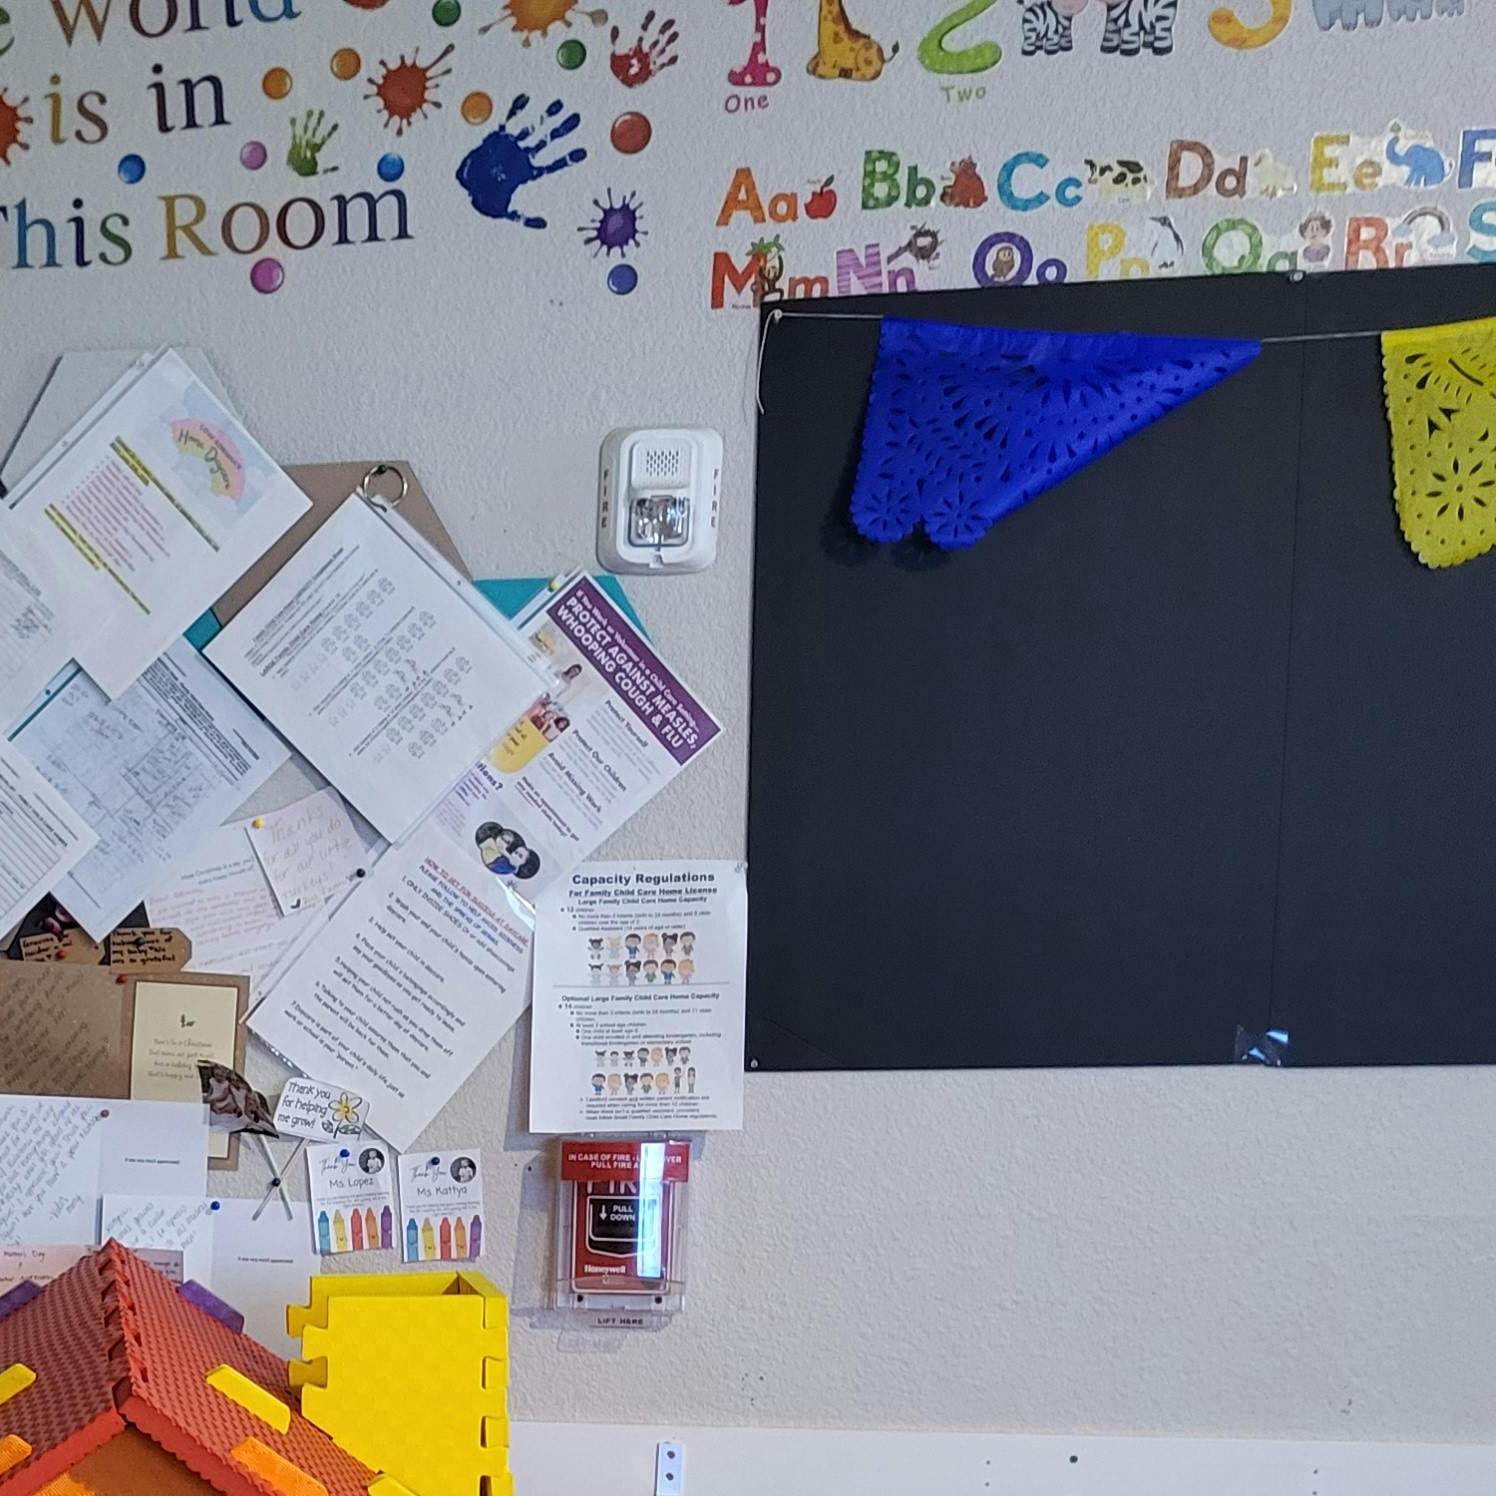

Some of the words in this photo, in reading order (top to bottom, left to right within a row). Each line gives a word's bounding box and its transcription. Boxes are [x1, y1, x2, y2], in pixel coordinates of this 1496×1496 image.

[45, 73, 109, 145] is
[147, 63, 231, 135] in
[724, 95, 769, 114] One
[941, 86, 986, 104] Two
[157, 186, 415, 261] Room
[601, 469, 609, 528] FIRE
[710, 469, 719, 528] FIRE
[554, 604, 617, 673] WHOOPING
[612, 670, 654, 715] COUGH
[650, 713, 664, 727] &
[660, 724, 683, 749] FLU
[564, 596, 611, 646] PROTECT
[606, 643, 656, 697] AGAINST
[649, 692, 701, 751] MEASLES,
[648, 672, 666, 691] Child
[662, 688, 679, 706] Care
[604, 699, 626, 723] Protect
[571, 728, 593, 753] Protect
[591, 751, 605, 765] Our
[602, 764, 628, 792] Children
[547, 751, 566, 771] Avoid
[562, 769, 587, 796] Missing
[584, 793, 603, 813] Work
[572, 873, 630, 887] Capacity
[635, 872, 714, 885] Regulations
[584, 889, 611, 897] Family
[591, 994, 608, 1002] Large
[611, 994, 631, 1002] Family
[691, 992, 719, 1000] Capacity
[287, 1080, 314, 1097] Thank
[313, 1088, 331, 1102] you
[281, 1094, 294, 1108] for
[293, 1096, 328, 1118] helping
[277, 1111, 290, 1123] me
[289, 1112, 316, 1132] grow!
[568, 1153, 576, 1161] IN
[578, 1153, 599, 1161] CASE
[600, 1153, 612, 1161] OF
[591, 1161, 611, 1169] PULL
[613, 1161, 632, 1169] FIRE
[347, 1176, 375, 1190] Lopez
[435, 1185, 468, 1199] Kattya
[610, 1213, 636, 1221] DOWN
[613, 1204, 633, 1213] PULL
[584, 1264, 626, 1274] Honeywell
